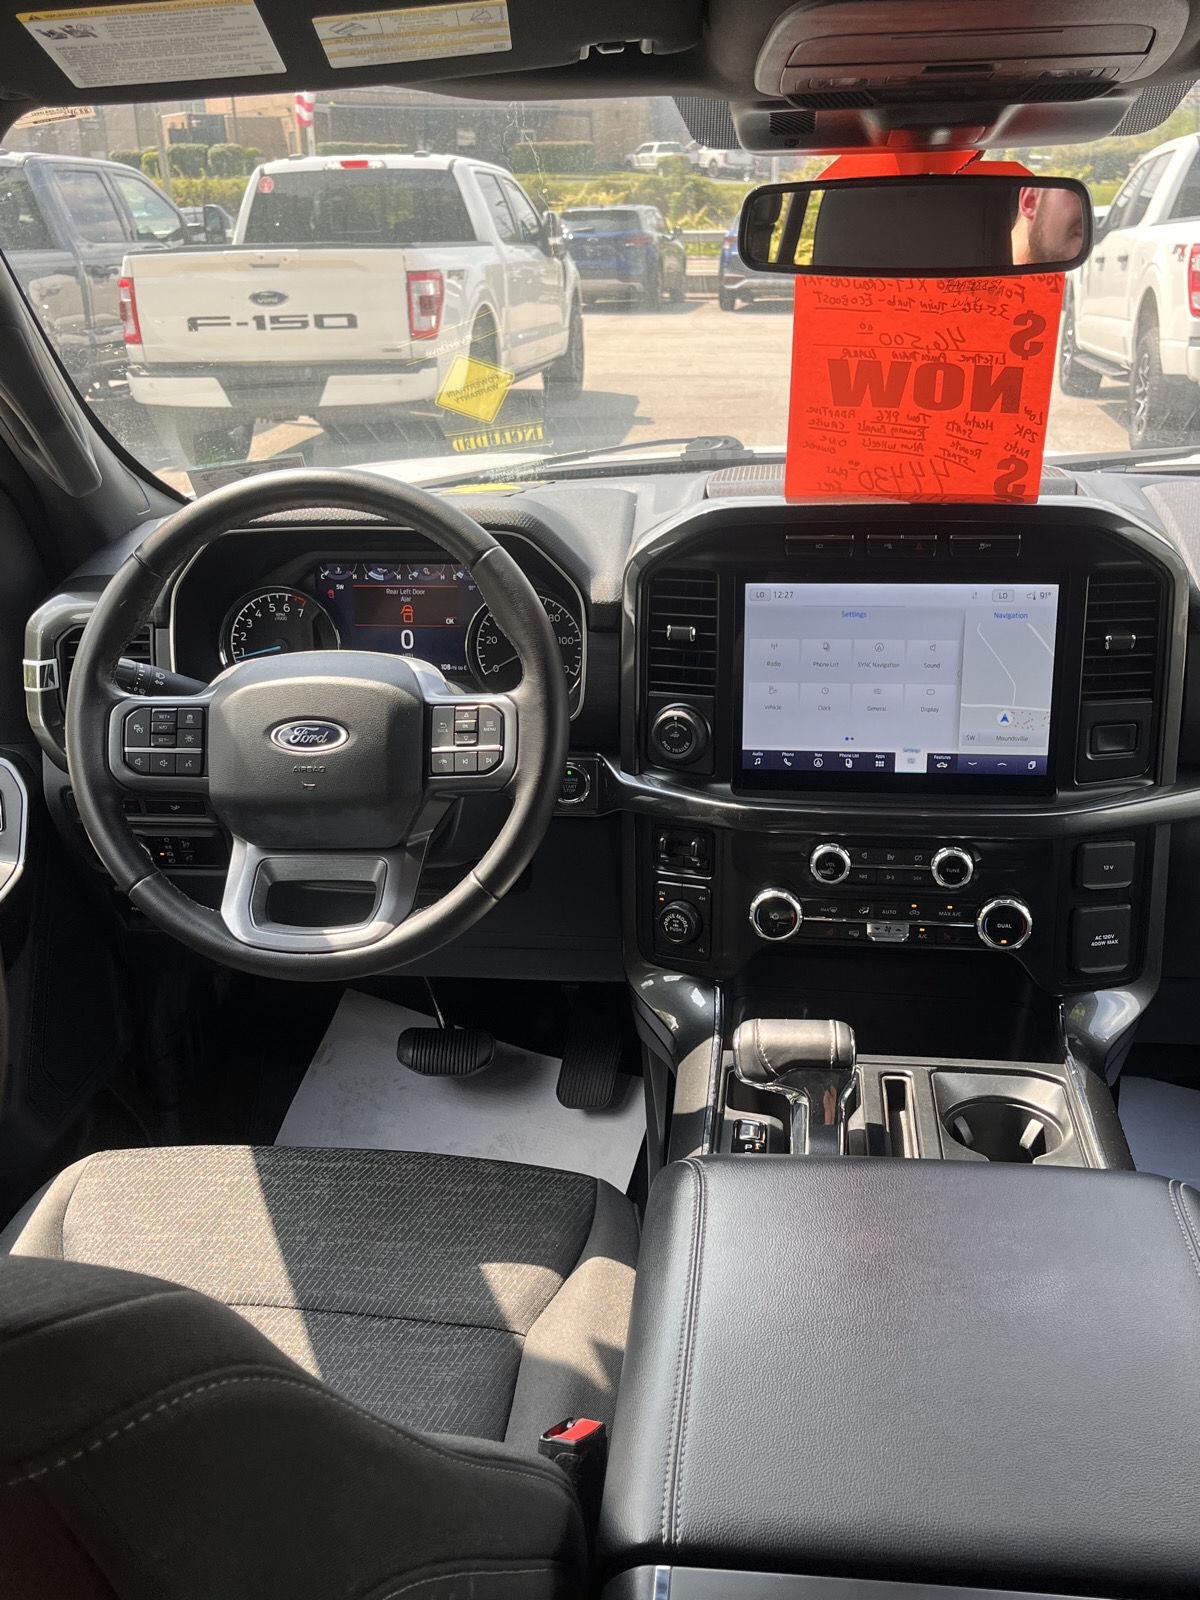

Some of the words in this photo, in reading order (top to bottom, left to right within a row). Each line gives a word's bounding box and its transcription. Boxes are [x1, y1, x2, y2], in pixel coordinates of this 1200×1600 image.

[187, 313, 358, 332] F-150
[773, 591, 794, 599] 12:27
[268, 603, 276, 612] 5
[282, 603, 291, 612] 6
[255, 609, 262, 618] 4
[297, 608, 304, 618] 7
[841, 611, 868, 619] Settings
[993, 612, 1029, 620] Navigation
[246, 619, 253, 628] 3
[240, 632, 247, 641] 2
[400, 629, 414, 650] 0
[486, 636, 498, 645] 20
[558, 636, 574, 645] 100
[920, 706, 939, 714] Display
[290, 726, 329, 744] Ford
